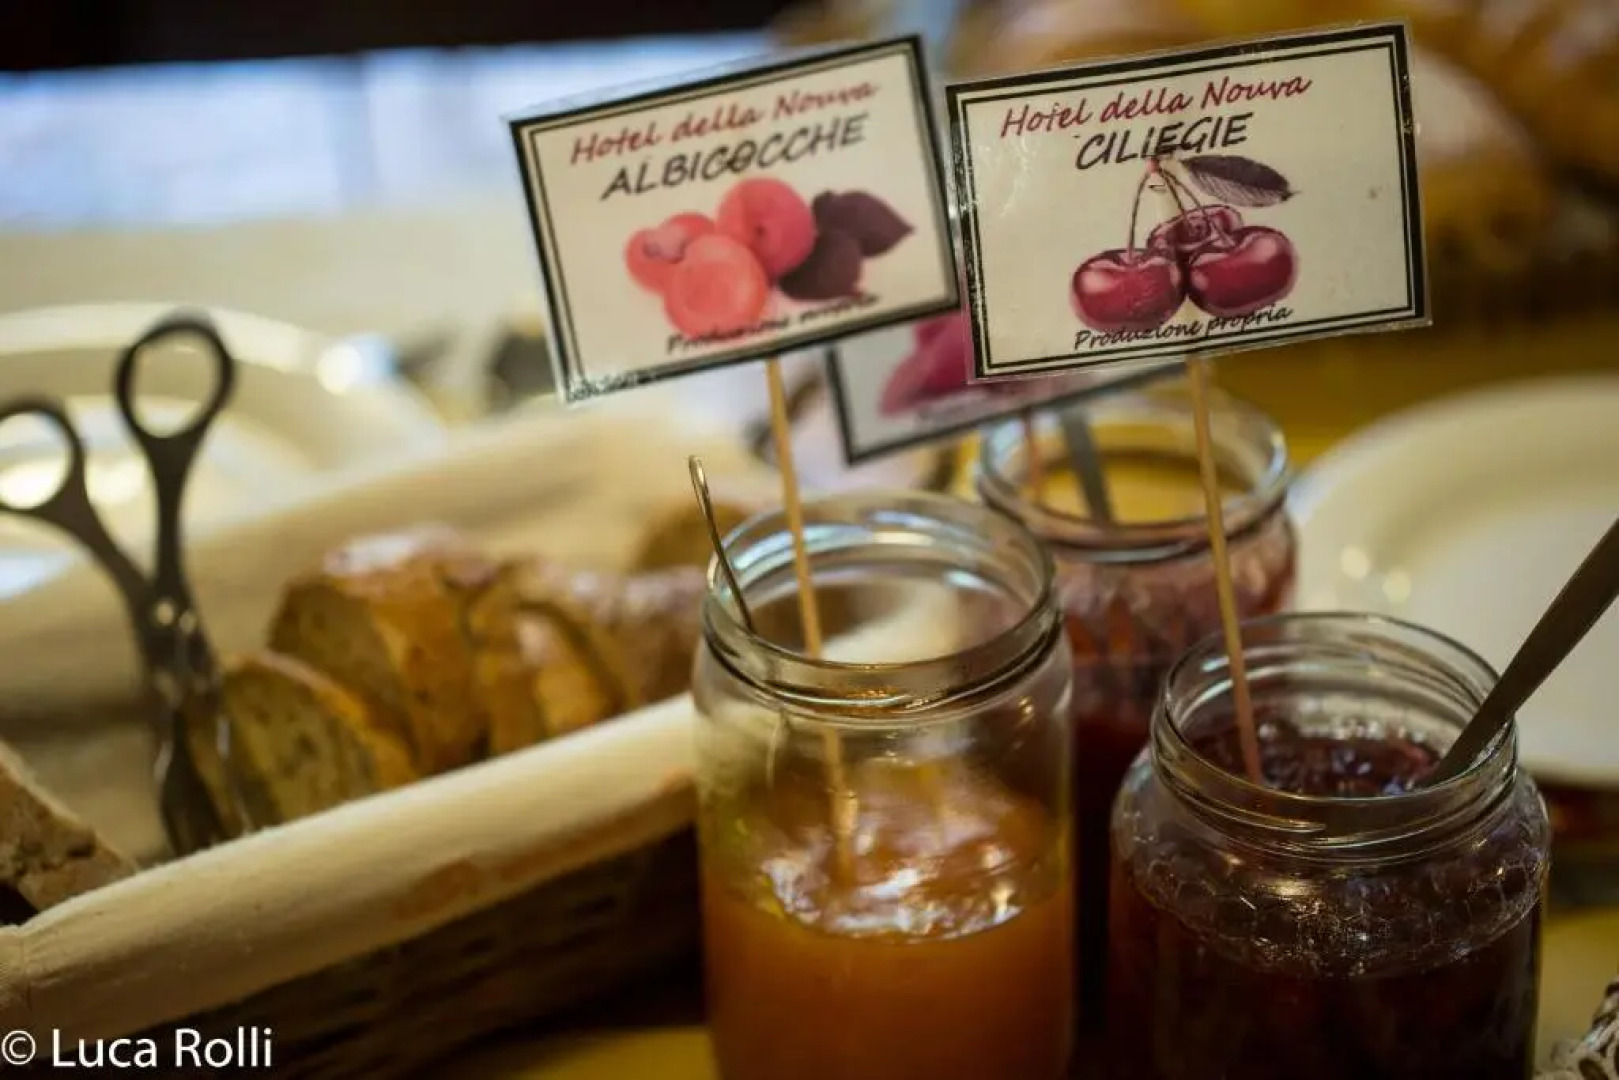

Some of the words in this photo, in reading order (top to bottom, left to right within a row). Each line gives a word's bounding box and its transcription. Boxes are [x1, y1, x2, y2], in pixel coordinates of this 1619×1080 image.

[1100, 87, 1194, 123] della
[1200, 76, 1312, 110] Nouva
[570, 122, 661, 165] Hotel
[1075, 112, 1253, 169] CILIEGIE
[1074, 320, 1201, 350] Produzione
[1205, 304, 1294, 338] propria
